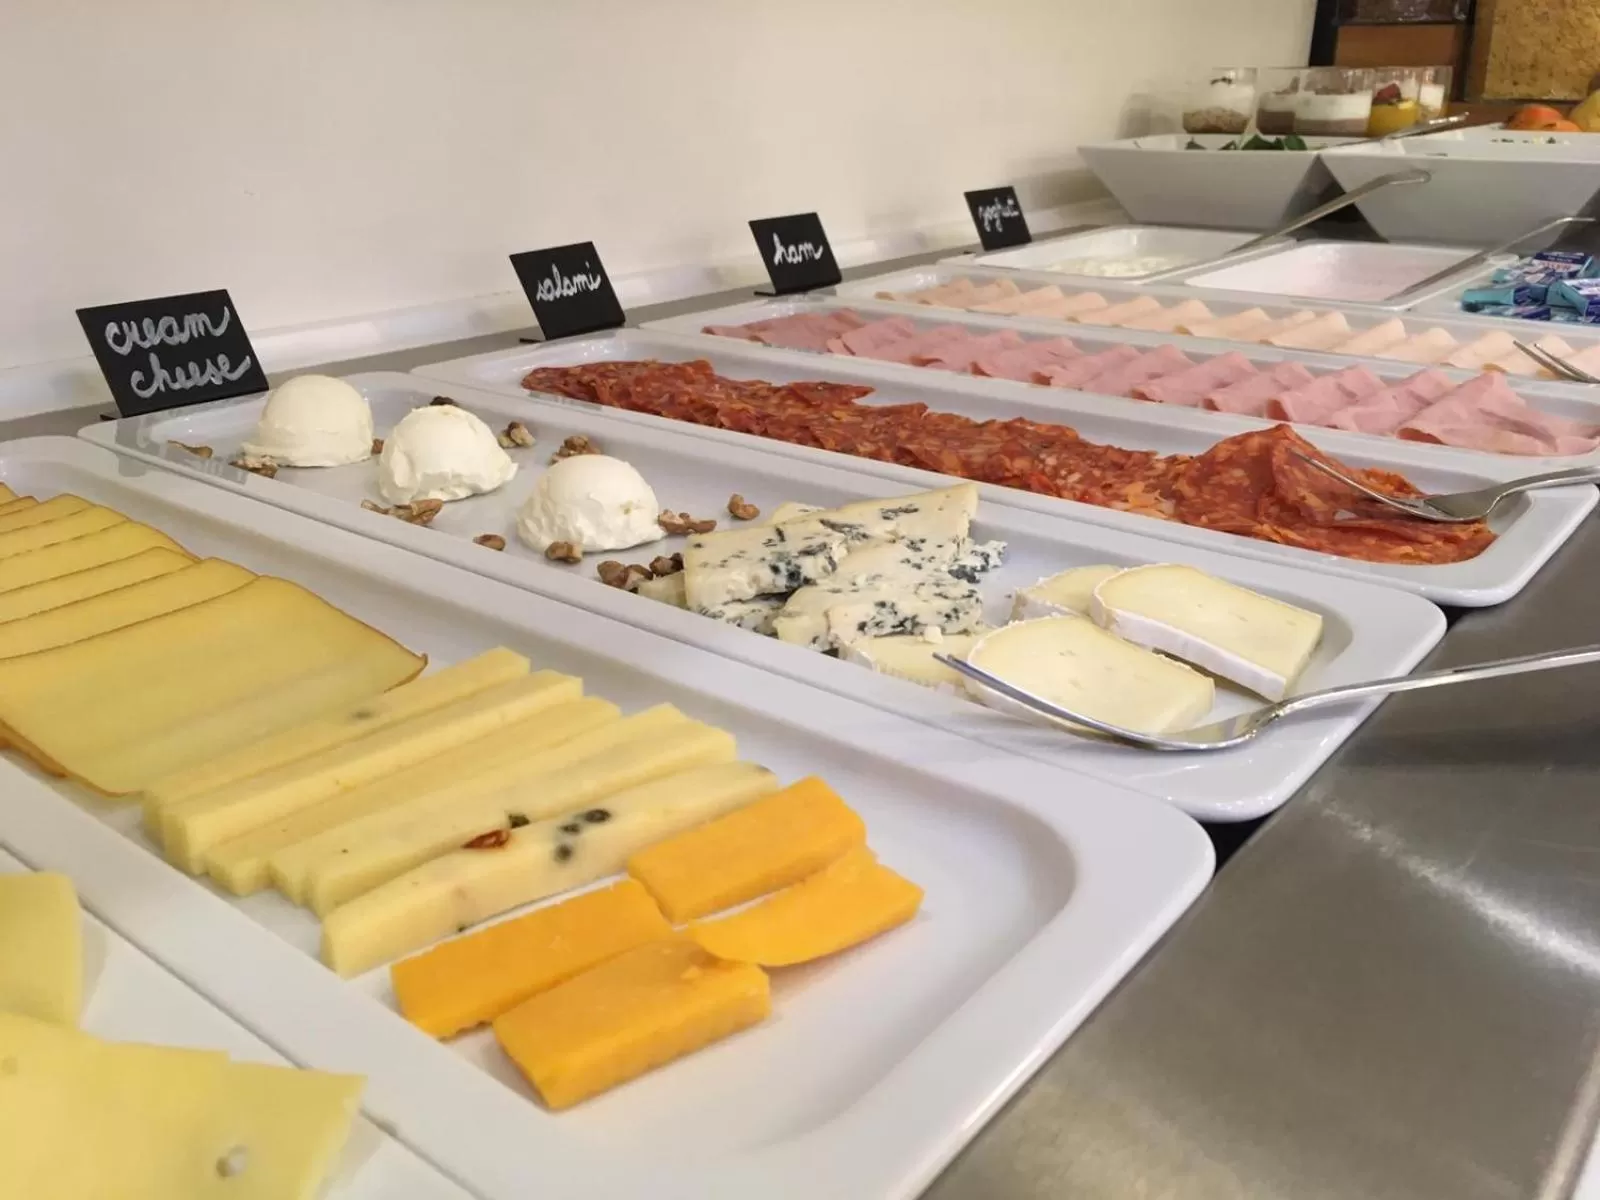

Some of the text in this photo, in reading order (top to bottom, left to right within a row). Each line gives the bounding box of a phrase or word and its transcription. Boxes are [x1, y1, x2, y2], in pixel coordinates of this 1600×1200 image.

[773, 232, 824, 266] ham
[536, 261, 601, 302] salami
[104, 305, 230, 356] cream
[130, 352, 252, 399] cheese
